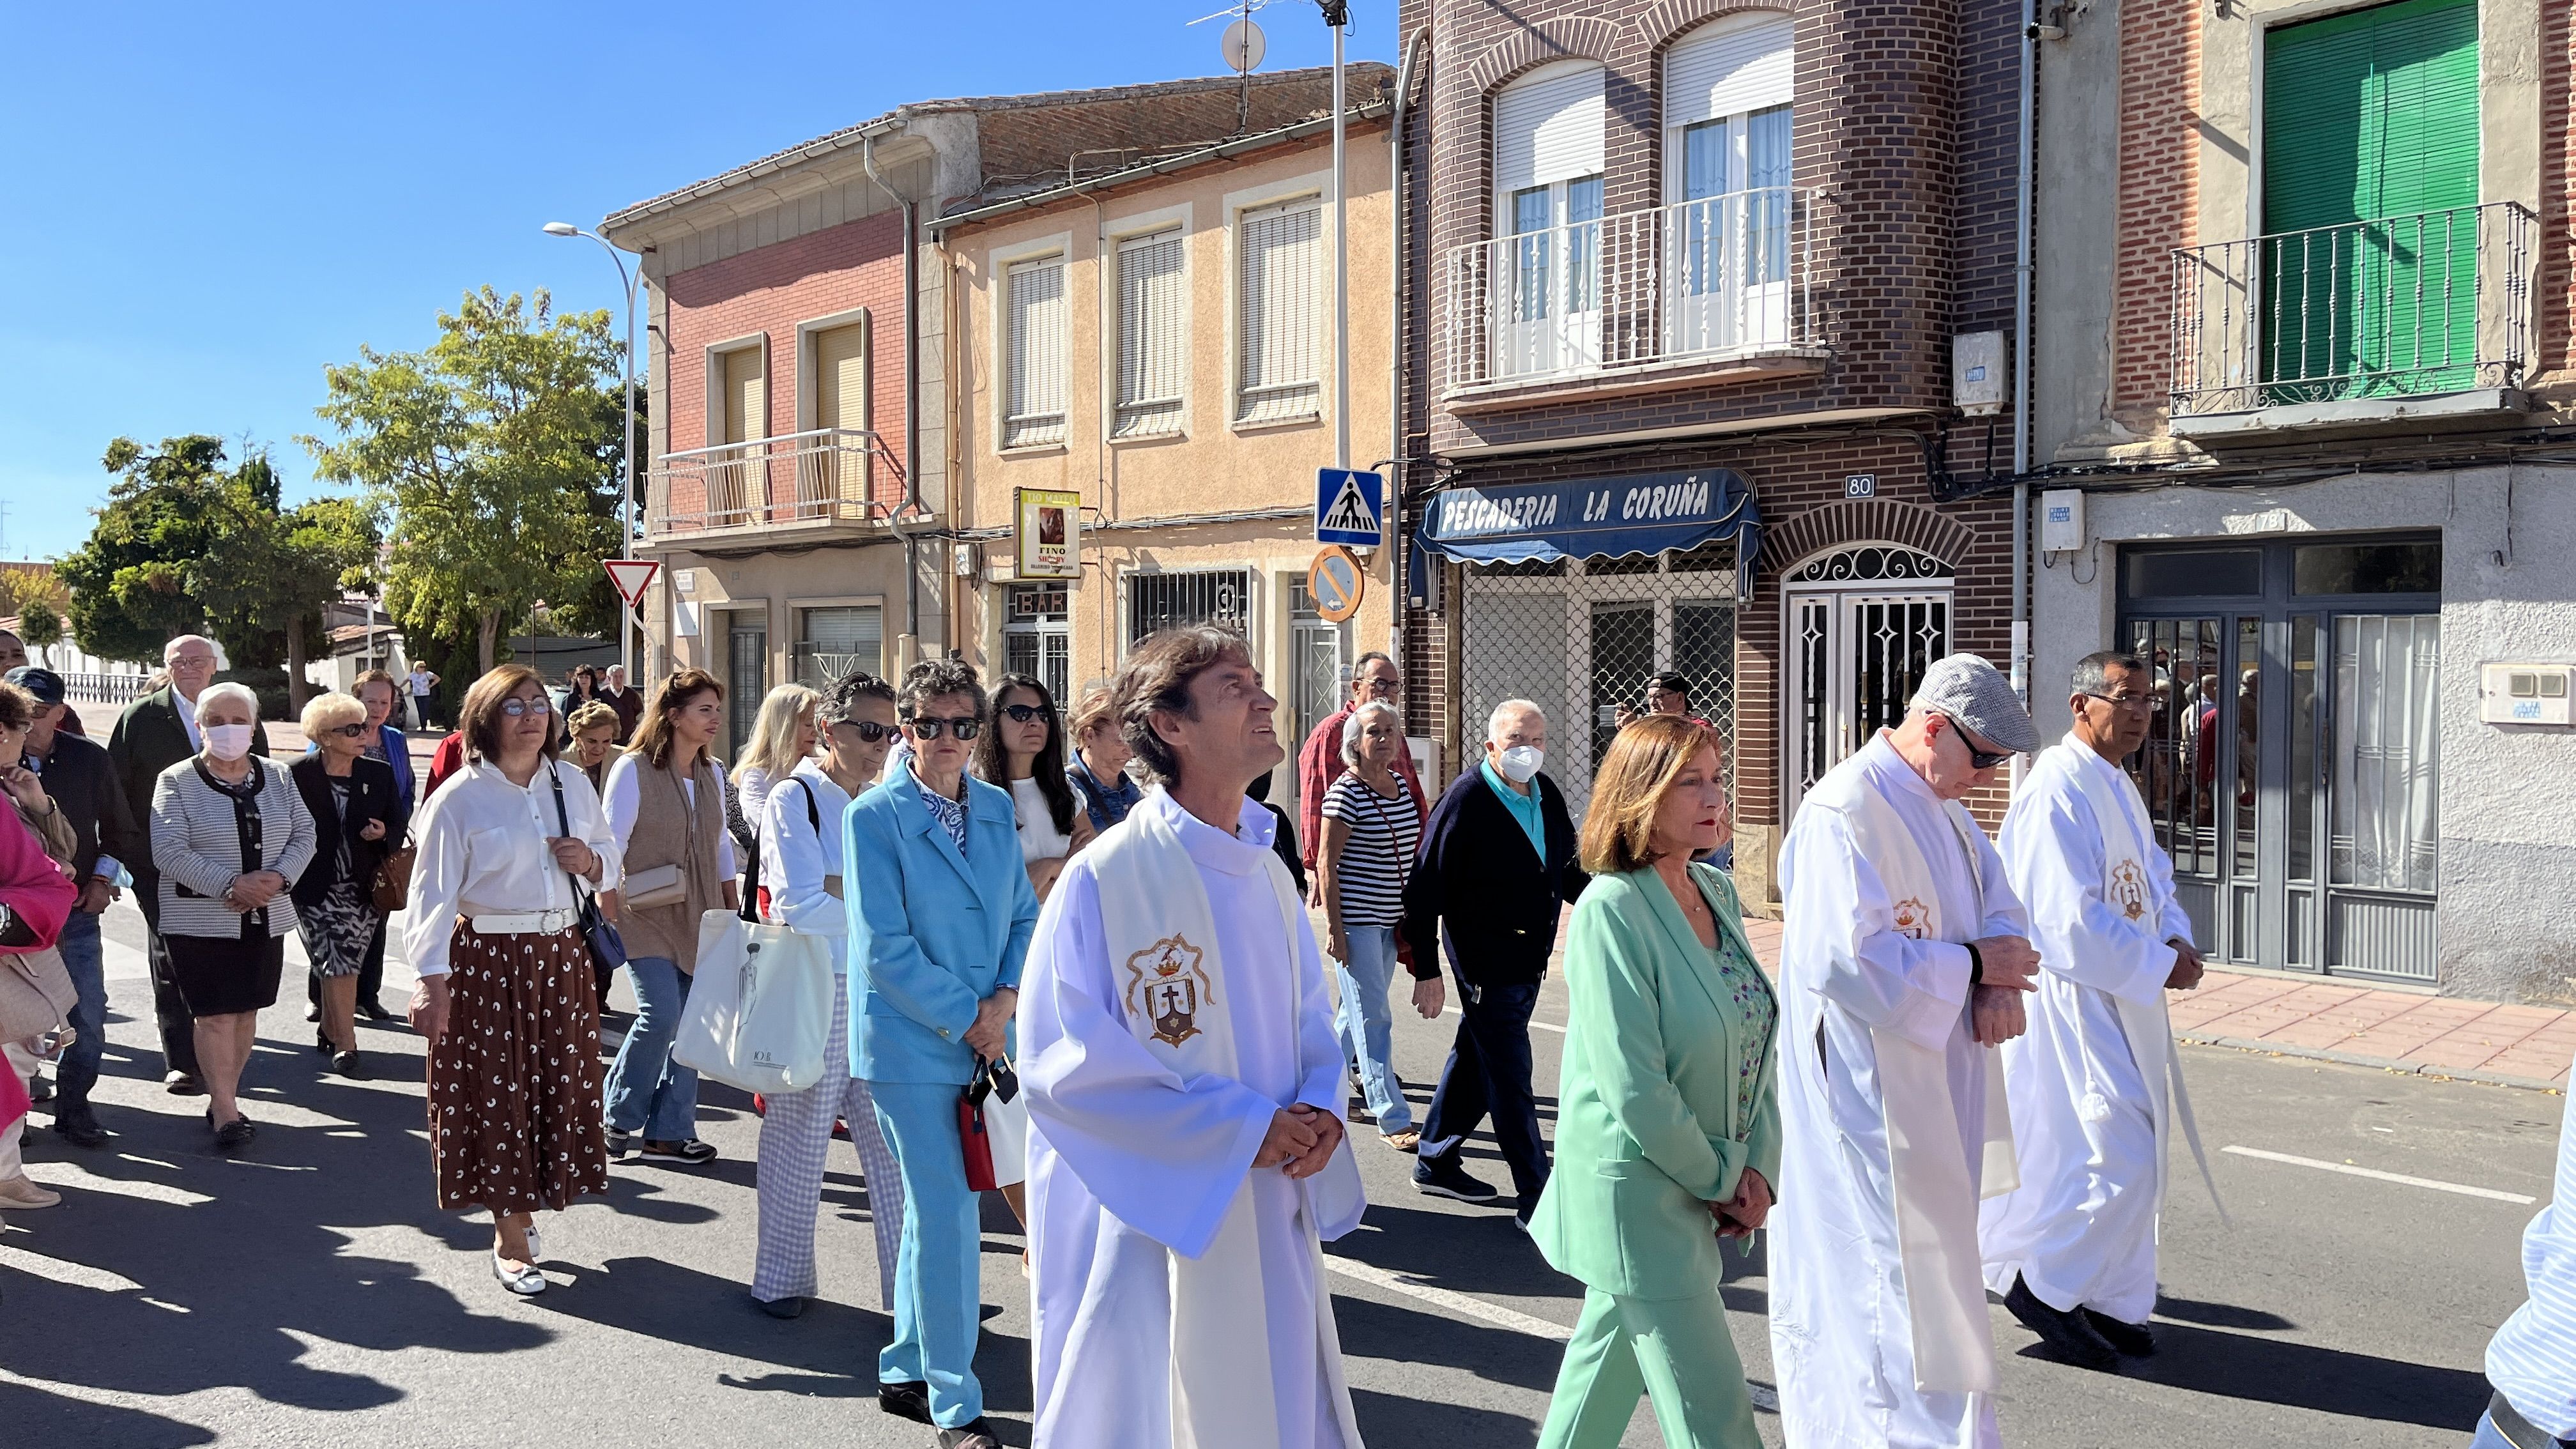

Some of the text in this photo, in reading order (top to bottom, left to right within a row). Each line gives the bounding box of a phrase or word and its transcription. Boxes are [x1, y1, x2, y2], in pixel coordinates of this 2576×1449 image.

[1850, 478, 1871, 495] 80
[1442, 476, 1708, 532] PESCADERIA LA CORUÑA
[2260, 514, 2278, 531] 78
[1021, 593, 1063, 613] BAR
